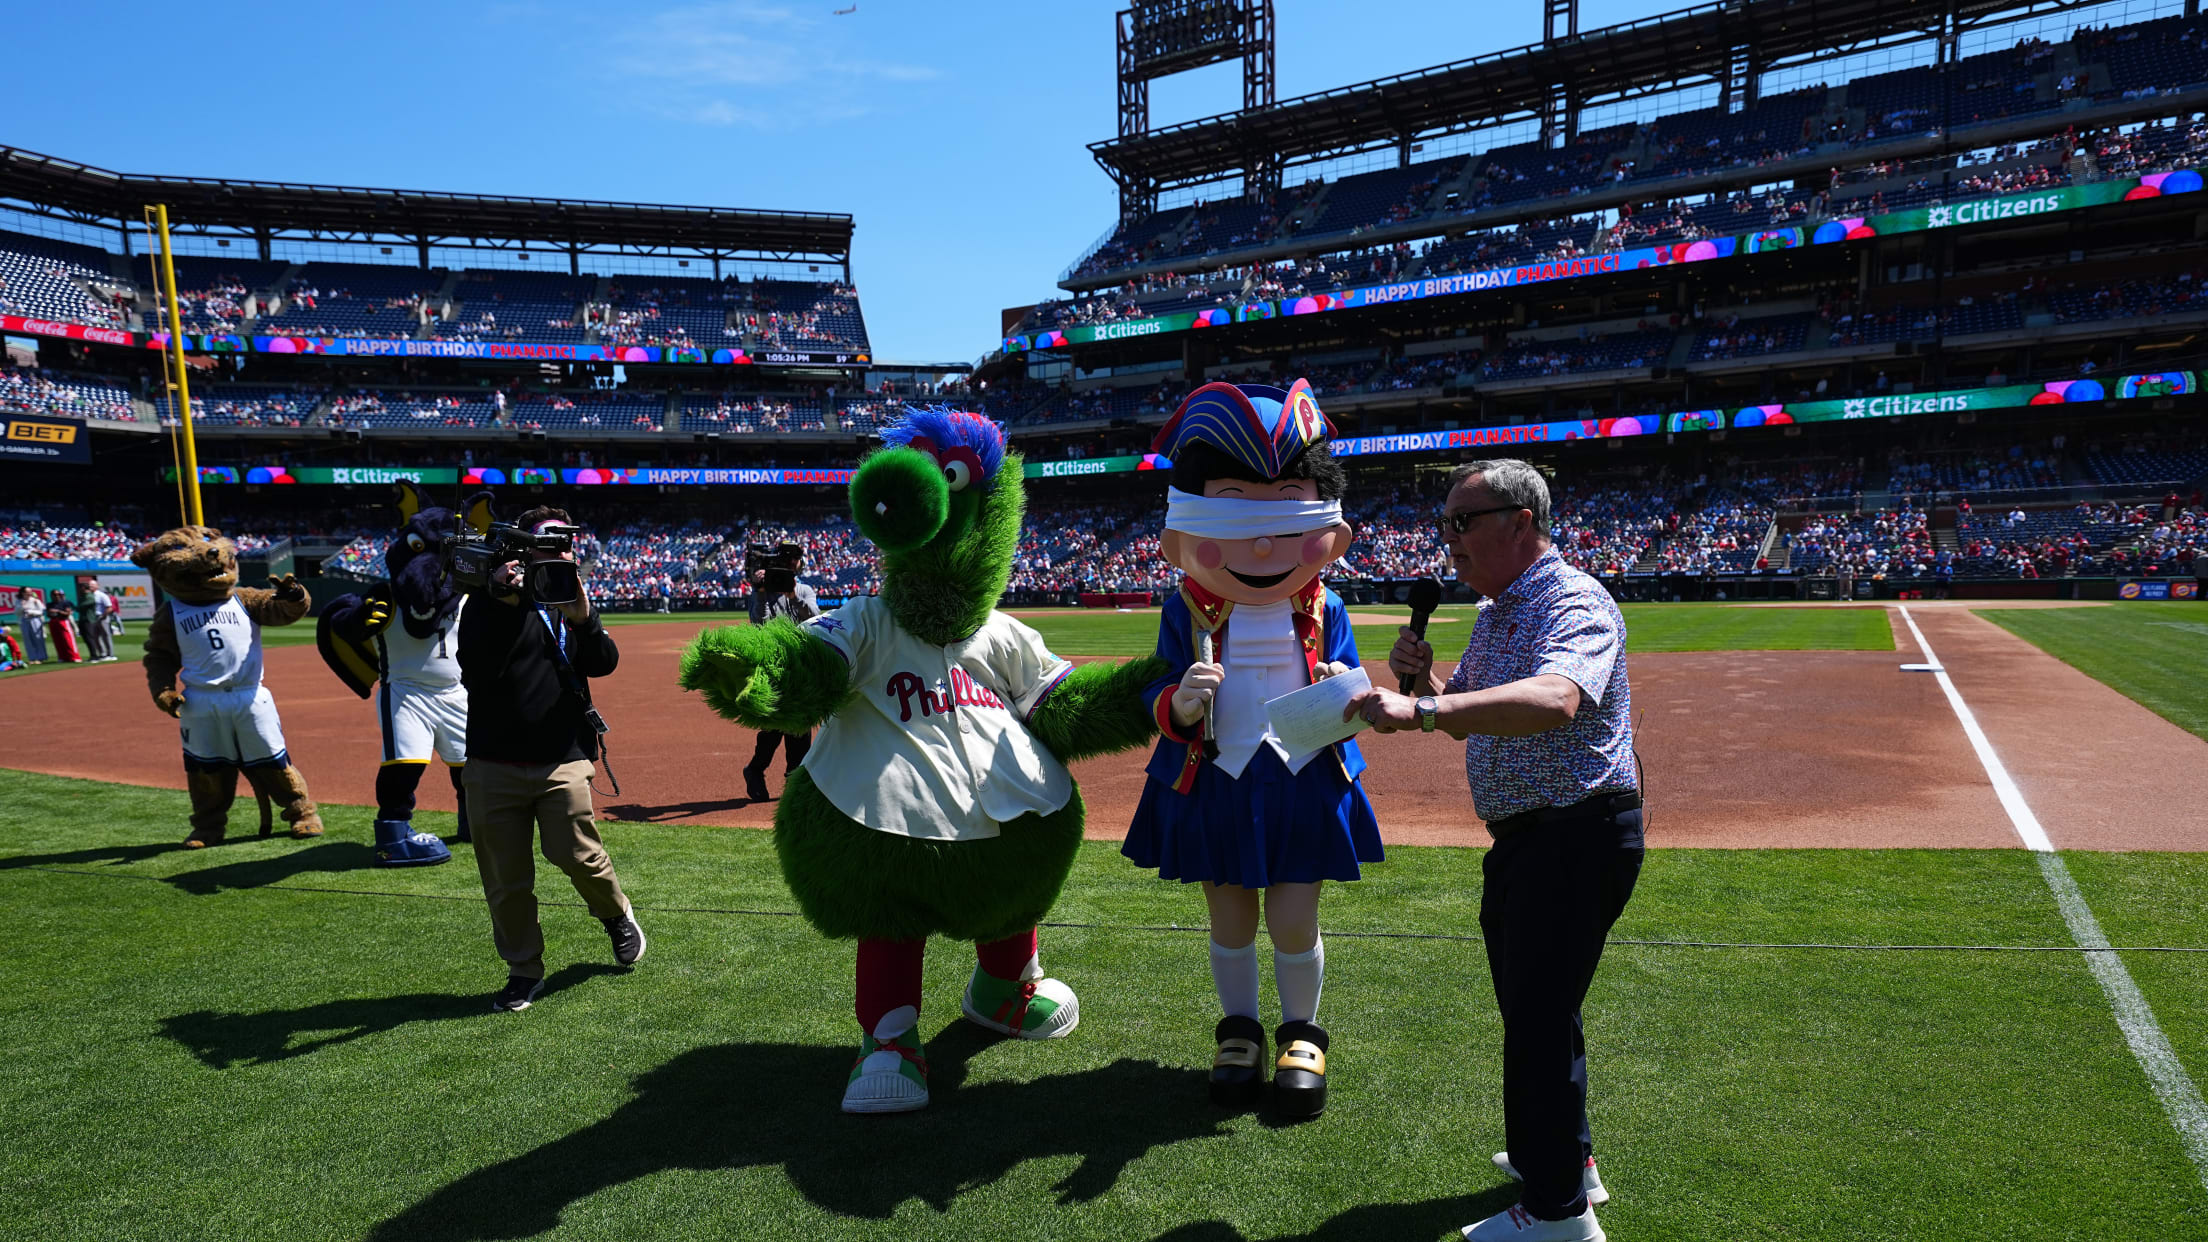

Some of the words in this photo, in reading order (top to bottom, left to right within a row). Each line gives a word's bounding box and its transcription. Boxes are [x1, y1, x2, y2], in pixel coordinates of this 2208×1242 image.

[1956, 194, 2058, 223] Citizens
[1365, 282, 1421, 304] HAPPY
[1425, 269, 1512, 297] BIRTHDAY
[1516, 255, 1619, 284] PHANATIC!
[1108, 320, 1161, 339] Citizens
[346, 339, 402, 355] HAPPY
[406, 341, 486, 357] BIRTHDAY
[490, 344, 576, 359] PHANATIC!
[796, 354, 810, 363] PM
[1868, 393, 1968, 417] Citizens
[1299, 398, 1315, 441] P
[15, 425, 70, 440] BET
[1361, 432, 1445, 454] BIRTHDAY
[1449, 425, 1549, 447] PHANATIC!
[351, 467, 421, 485] Citizens
[649, 470, 702, 485] HAPPY
[705, 470, 780, 485] BIRTHDAY
[1055, 461, 1107, 477] Citizens
[180, 610, 240, 635] VILLANOVA
[207, 628, 225, 651] 6
[886, 668, 1005, 722] Phillies
